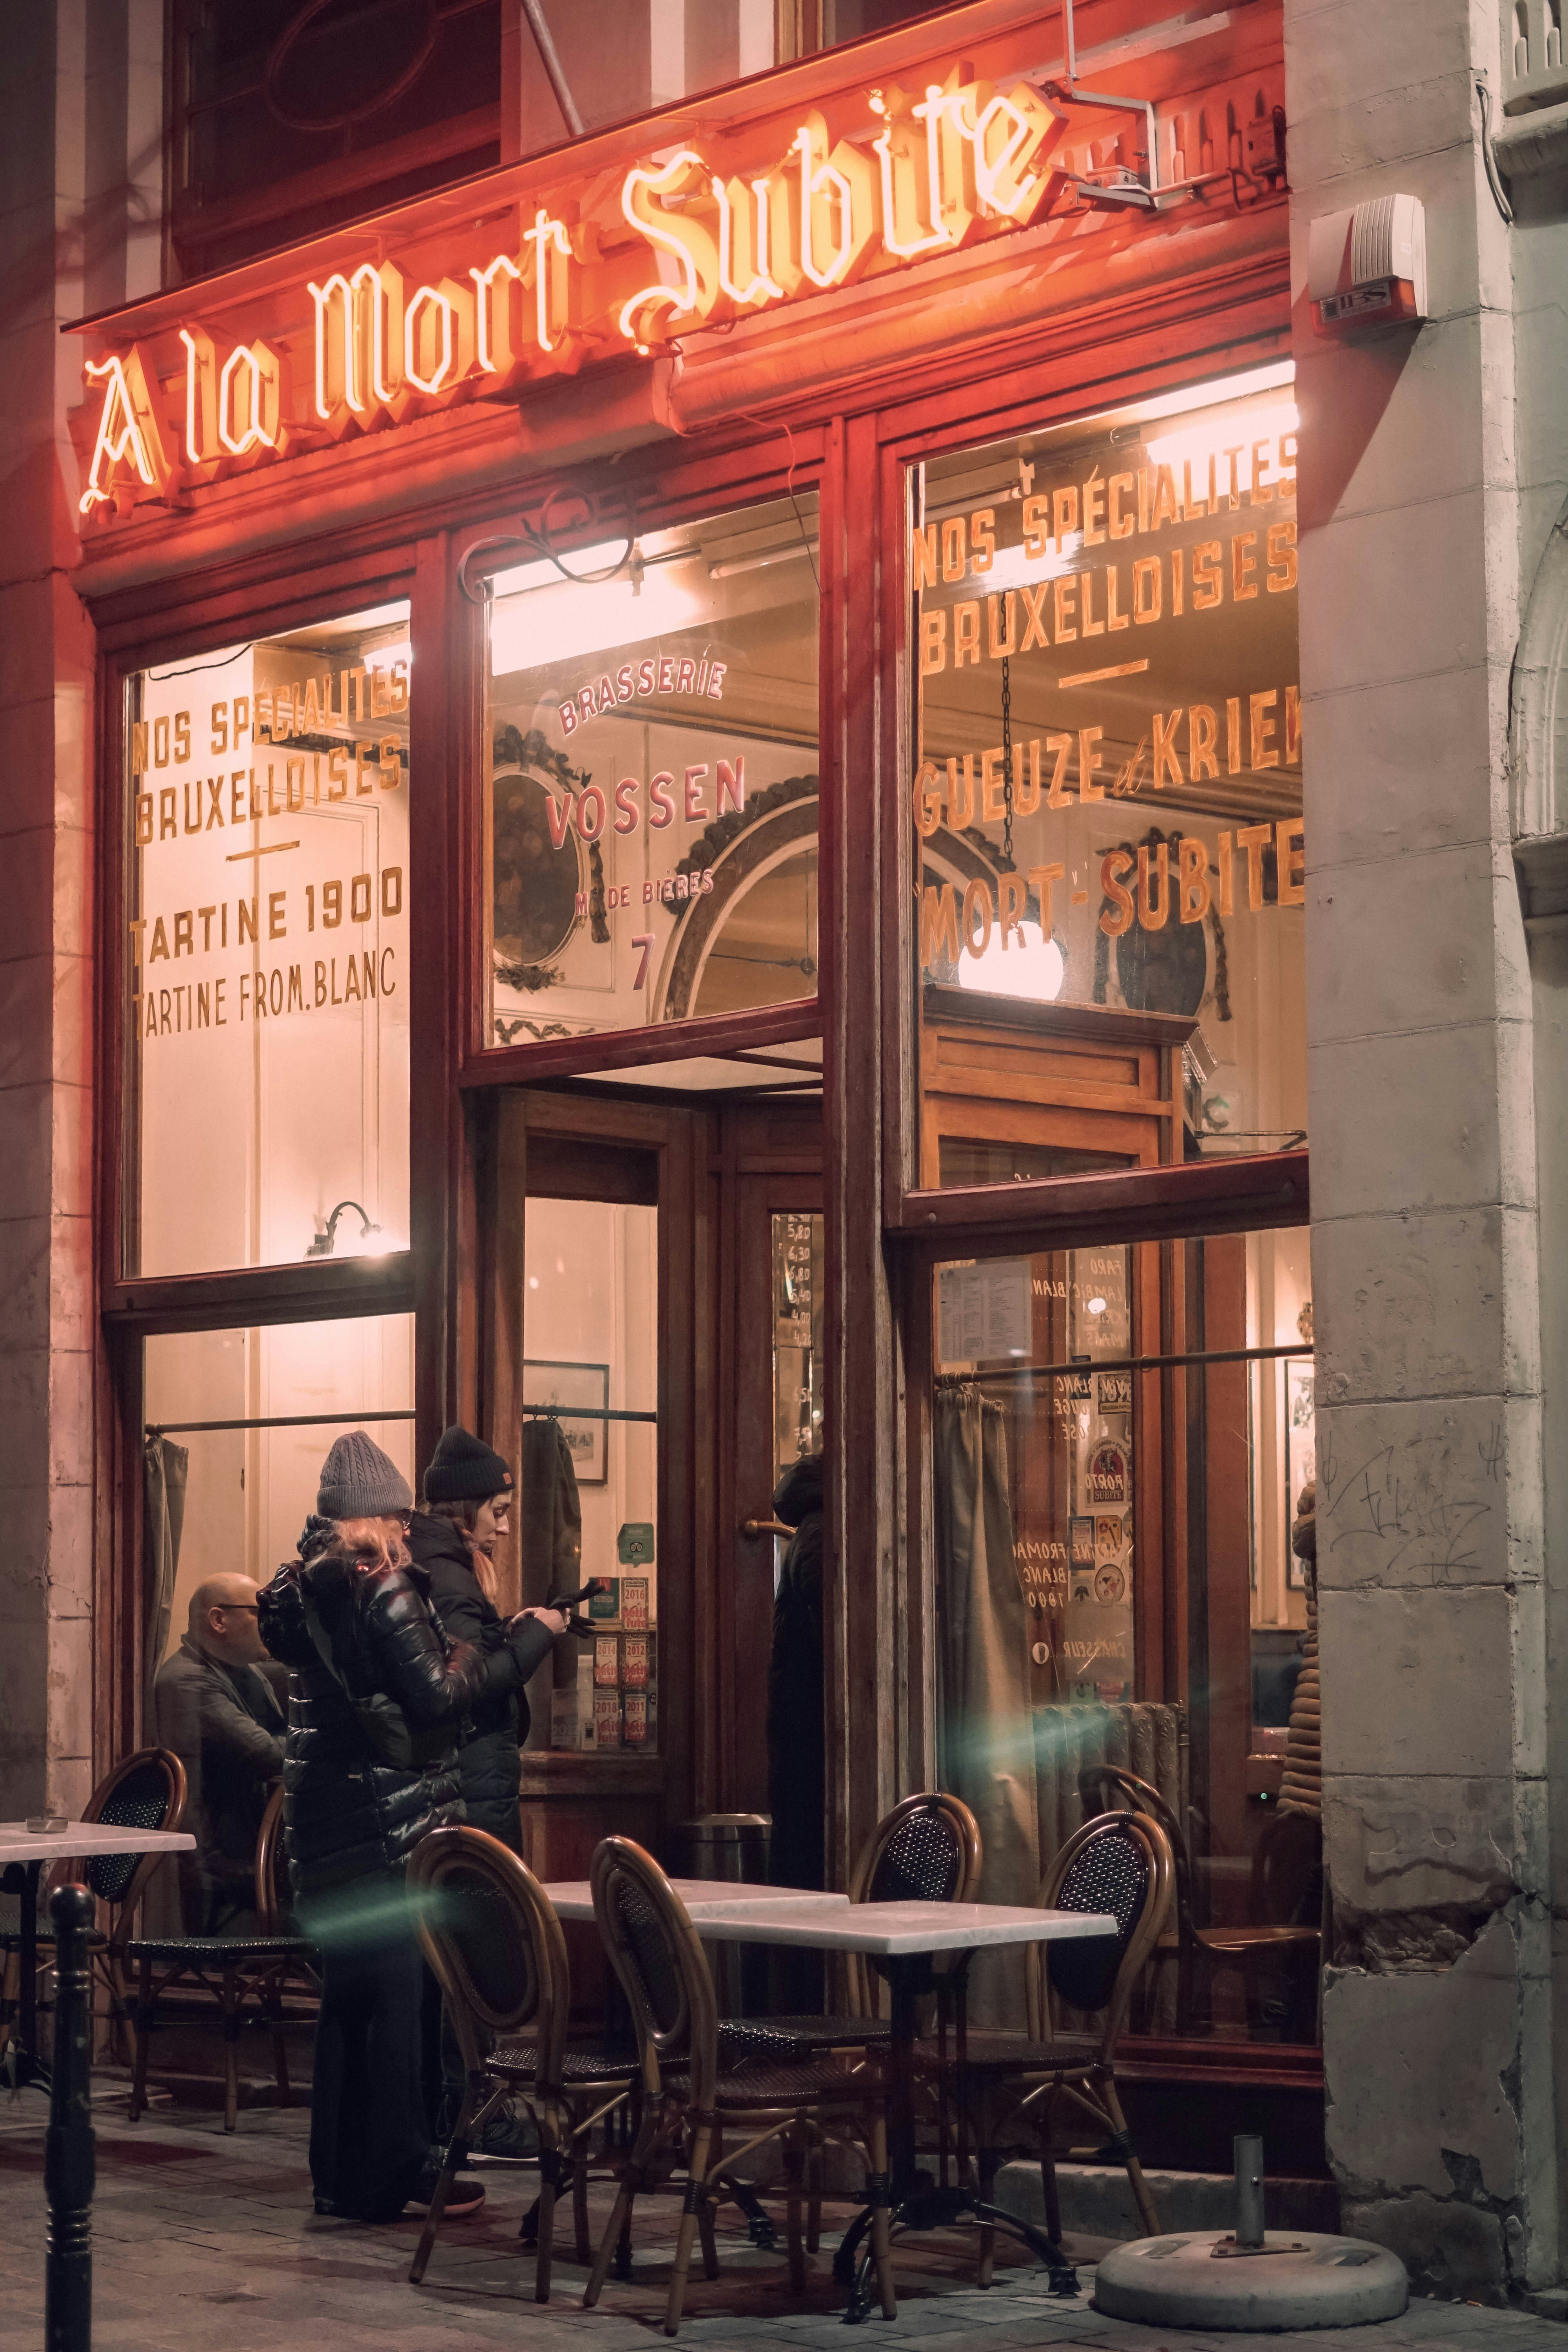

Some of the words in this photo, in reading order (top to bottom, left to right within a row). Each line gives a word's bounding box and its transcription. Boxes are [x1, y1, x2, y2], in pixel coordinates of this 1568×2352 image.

[79, 343, 172, 519] A
[180, 323, 290, 470] la
[307, 204, 580, 429] Mort
[620, 71, 1064, 355] Subite
[913, 509, 996, 590] NOS
[922, 521, 1297, 675] BRUXELLOISES
[133, 711, 190, 775] NOS
[914, 726, 1104, 837] GUEUZE
[1112, 734, 1149, 798] et
[136, 734, 401, 847] BRUXELLOISES
[545, 756, 745, 849] VOSSEN
[129, 891, 287, 966] TARTINE
[305, 866, 402, 932] 1900
[608, 884, 630, 909] DE
[1099, 817, 1304, 936] SUBITE
[632, 933, 655, 990] 7
[133, 978, 227, 1040] TARTINE
[625, 1588, 645, 1600] 2016
[627, 1645, 645, 1655] 2012
